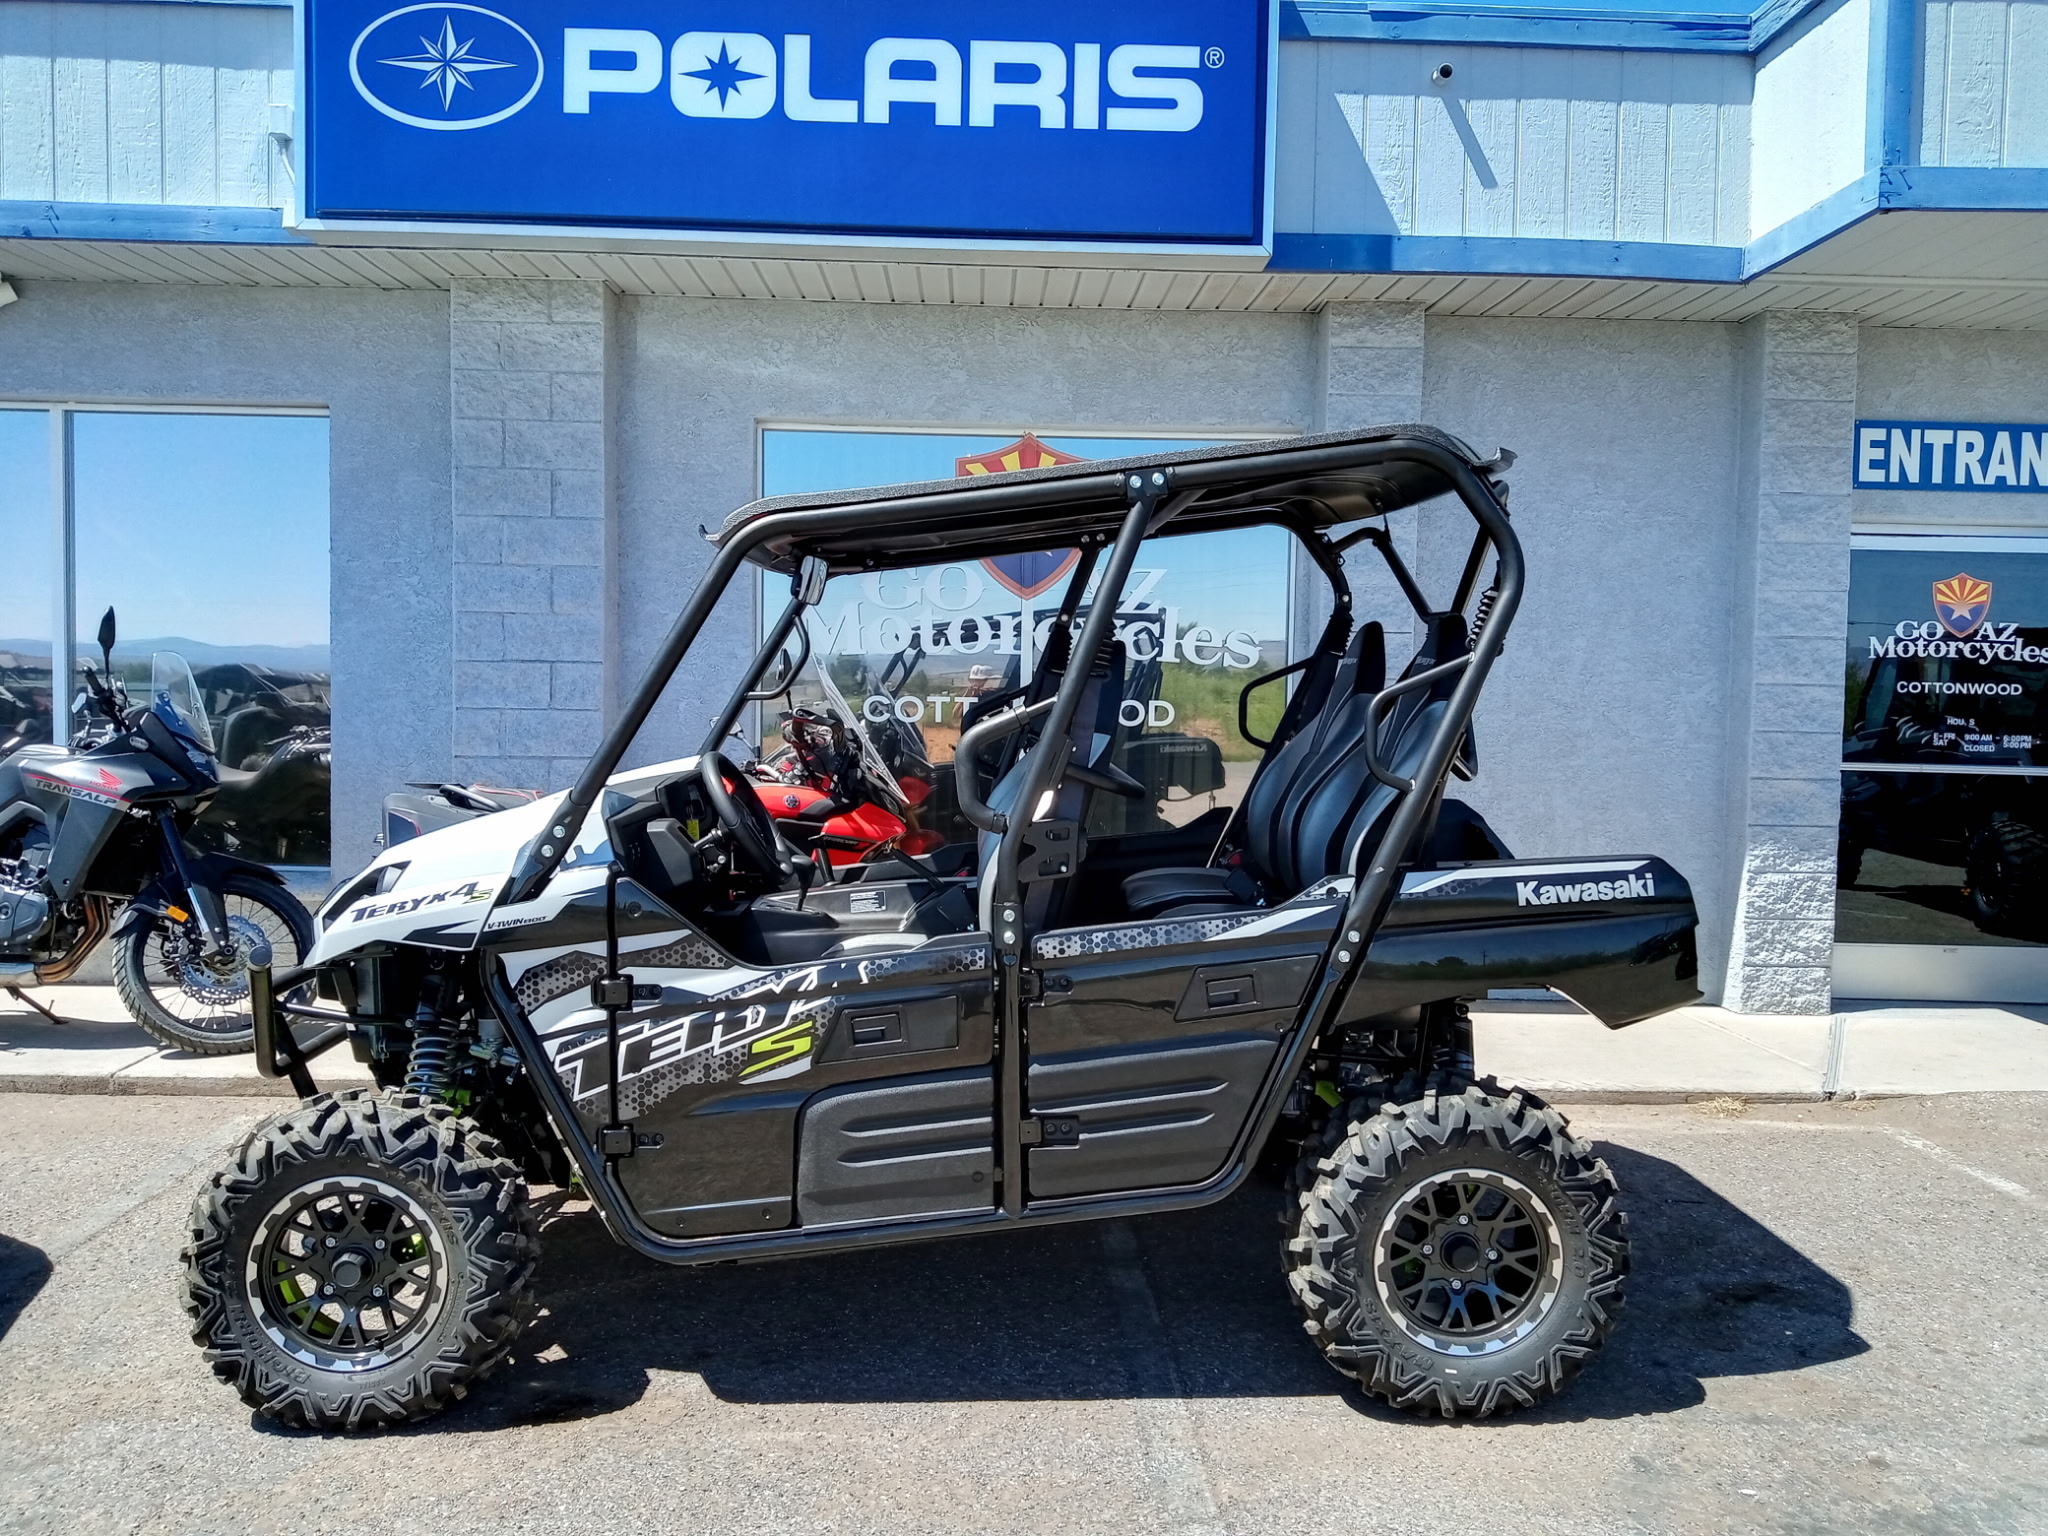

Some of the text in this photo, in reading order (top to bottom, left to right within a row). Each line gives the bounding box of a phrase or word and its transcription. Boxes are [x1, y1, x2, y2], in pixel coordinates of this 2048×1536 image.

[563, 27, 1204, 132] POLARIS
[1858, 427, 2048, 486] ENTRAN
[860, 566, 987, 612] GO
[1895, 620, 2019, 642] GO AZ
[1868, 636, 2048, 665] Motorcycles
[1896, 681, 2023, 696] COTTONWOOD
[863, 695, 1175, 727] COTTOD
[1947, 718, 1975, 726] HOUS
[1964, 744, 1995, 752] CLOSED
[36, 779, 118, 804] TRANSALP
[1516, 872, 1655, 907] Kawasaki
